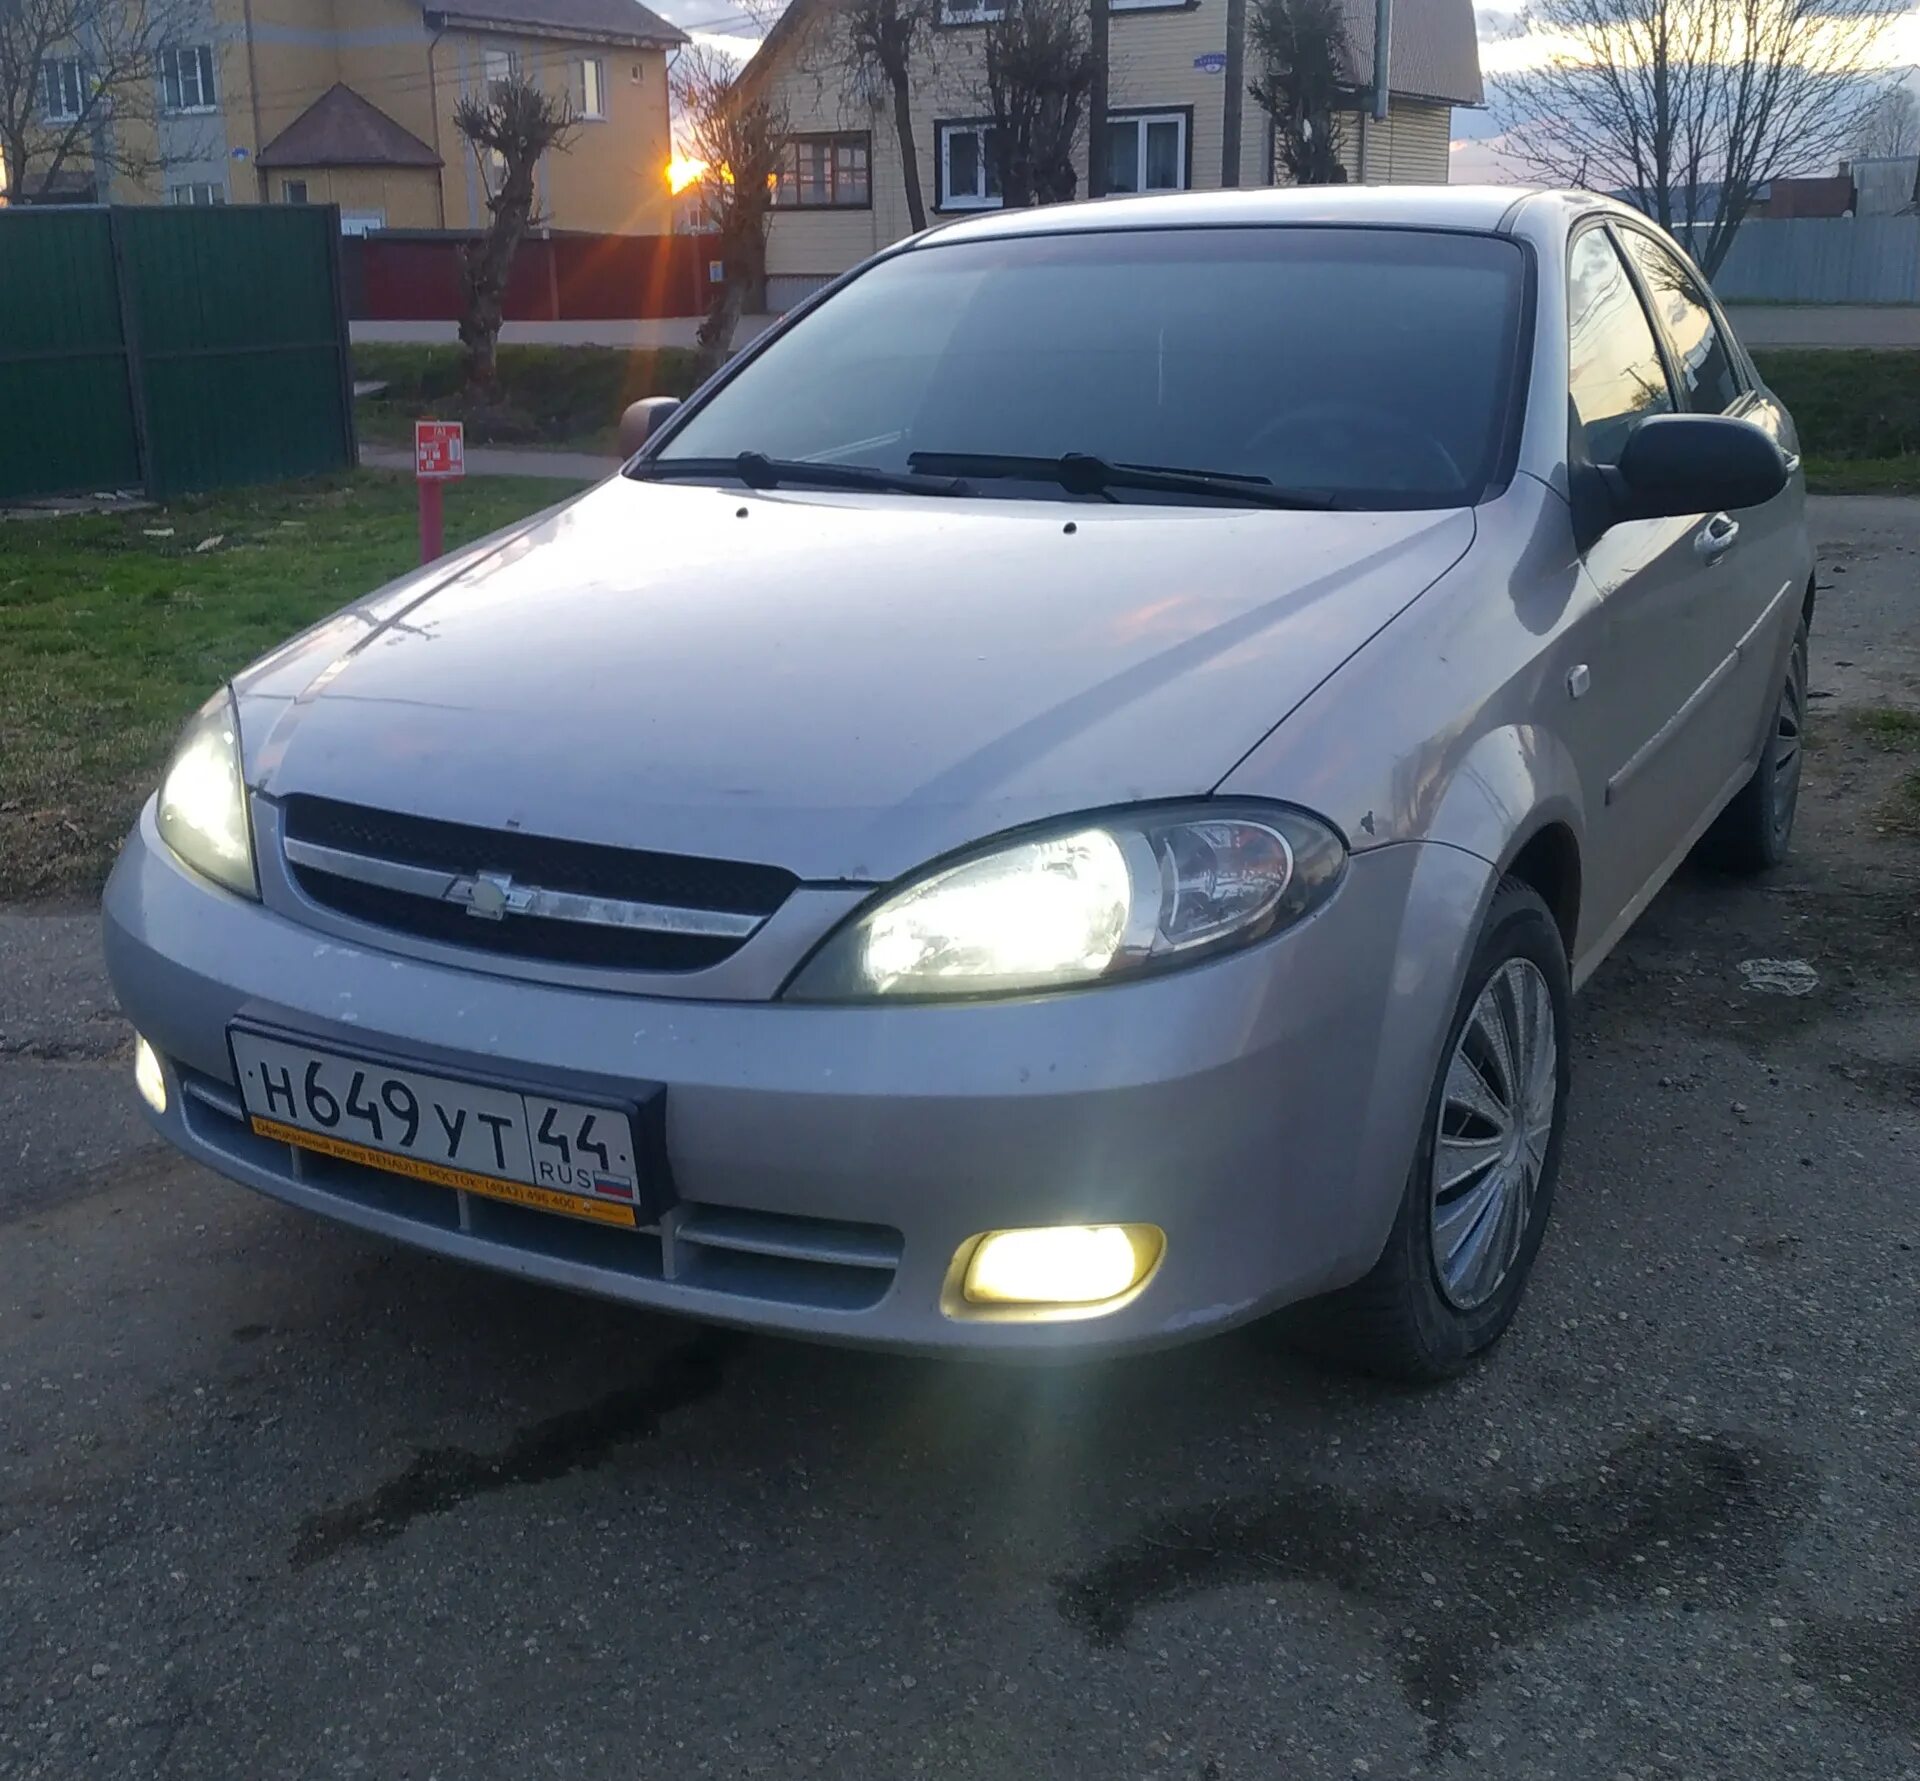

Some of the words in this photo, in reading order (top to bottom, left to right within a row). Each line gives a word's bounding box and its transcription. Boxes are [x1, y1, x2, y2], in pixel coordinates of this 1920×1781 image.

[538, 1107, 610, 1170] 44
[368, 1152, 420, 1174] RENAULT
[539, 1161, 592, 1190] RUS
